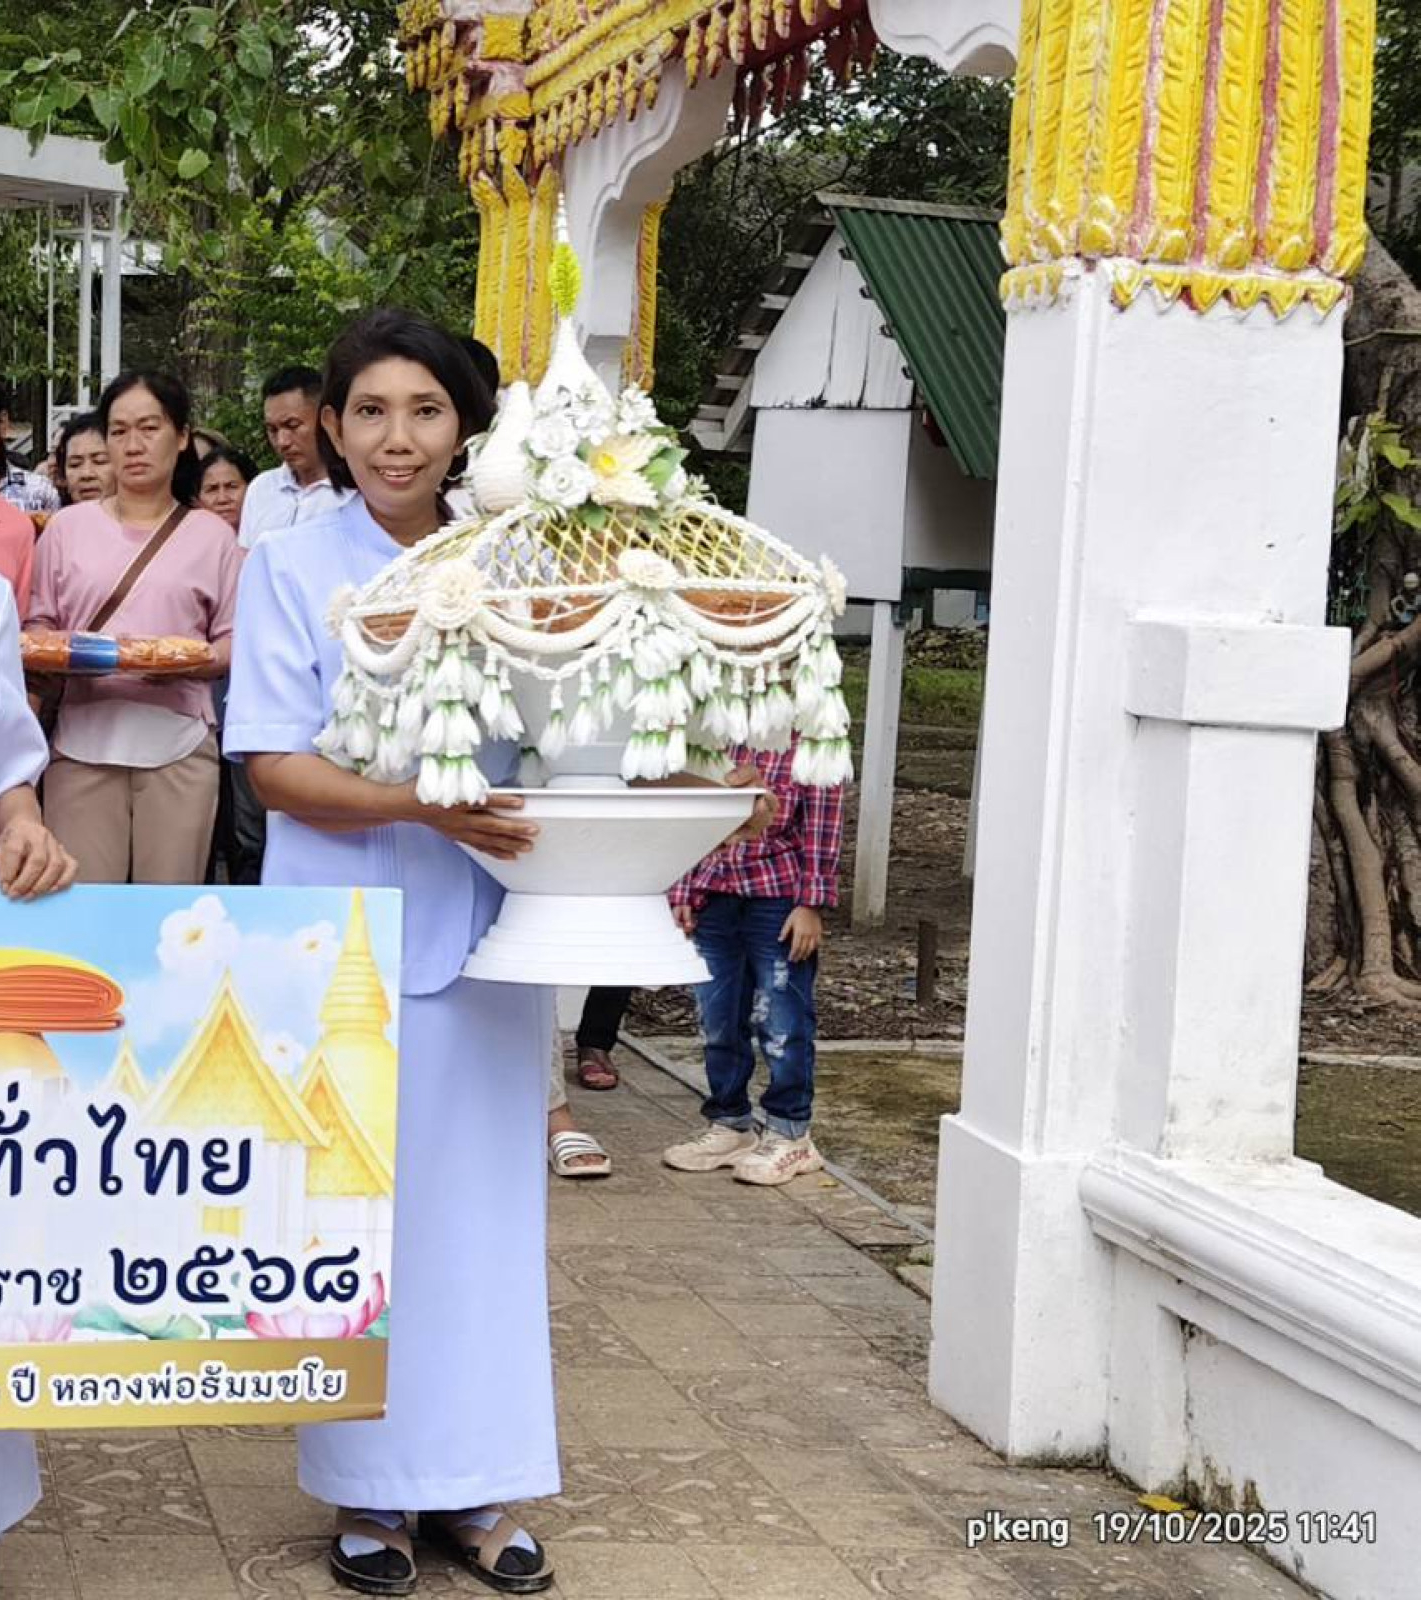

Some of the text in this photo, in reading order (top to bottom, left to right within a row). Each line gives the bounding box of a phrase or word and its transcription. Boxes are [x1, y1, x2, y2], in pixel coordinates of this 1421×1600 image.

[109, 1242, 361, 1304] ๒๕๖๘
[12, 1365, 36, 1403] ปี
[52, 1361, 343, 1401] หลวงพ่อธัมมชโย
